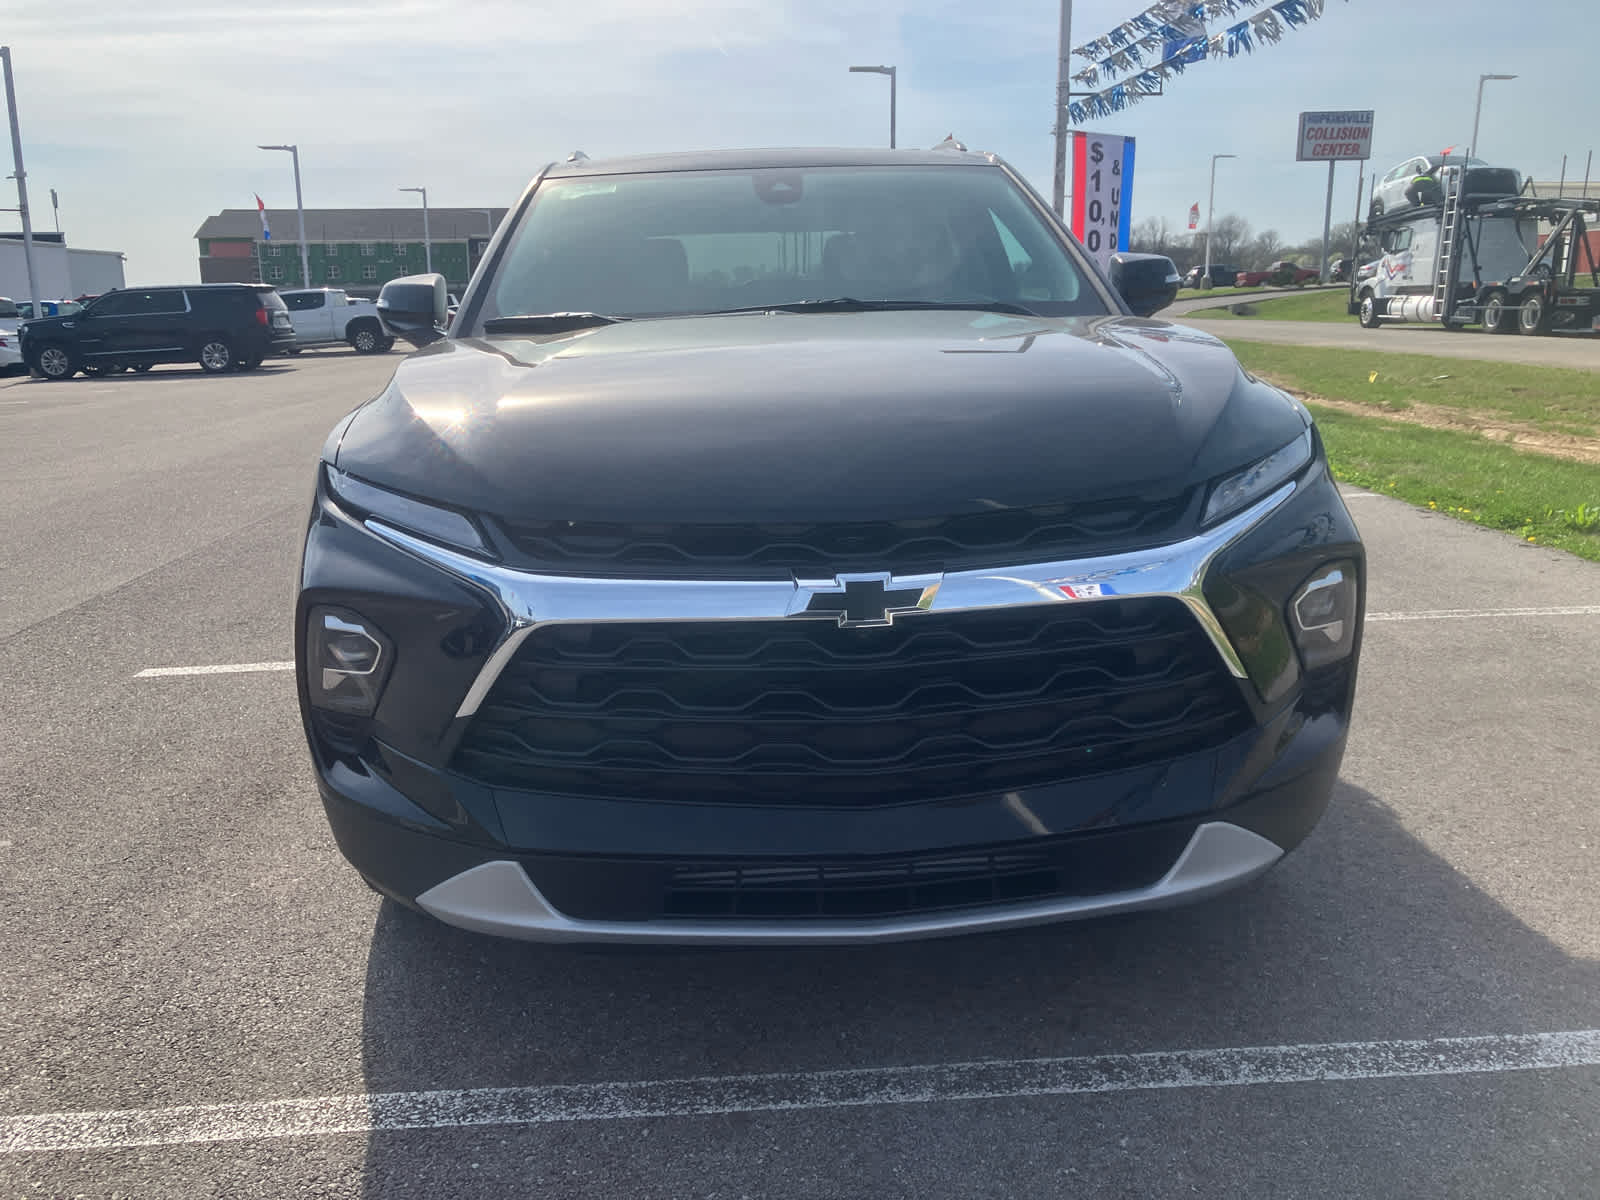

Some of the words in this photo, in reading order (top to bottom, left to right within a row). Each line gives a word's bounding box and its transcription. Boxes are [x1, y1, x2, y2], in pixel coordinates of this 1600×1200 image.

[1306, 127, 1370, 140] COLLISION
[1312, 143, 1361, 157] CENTER
[1112, 159, 1121, 176] &
[1109, 187, 1120, 256] UND
